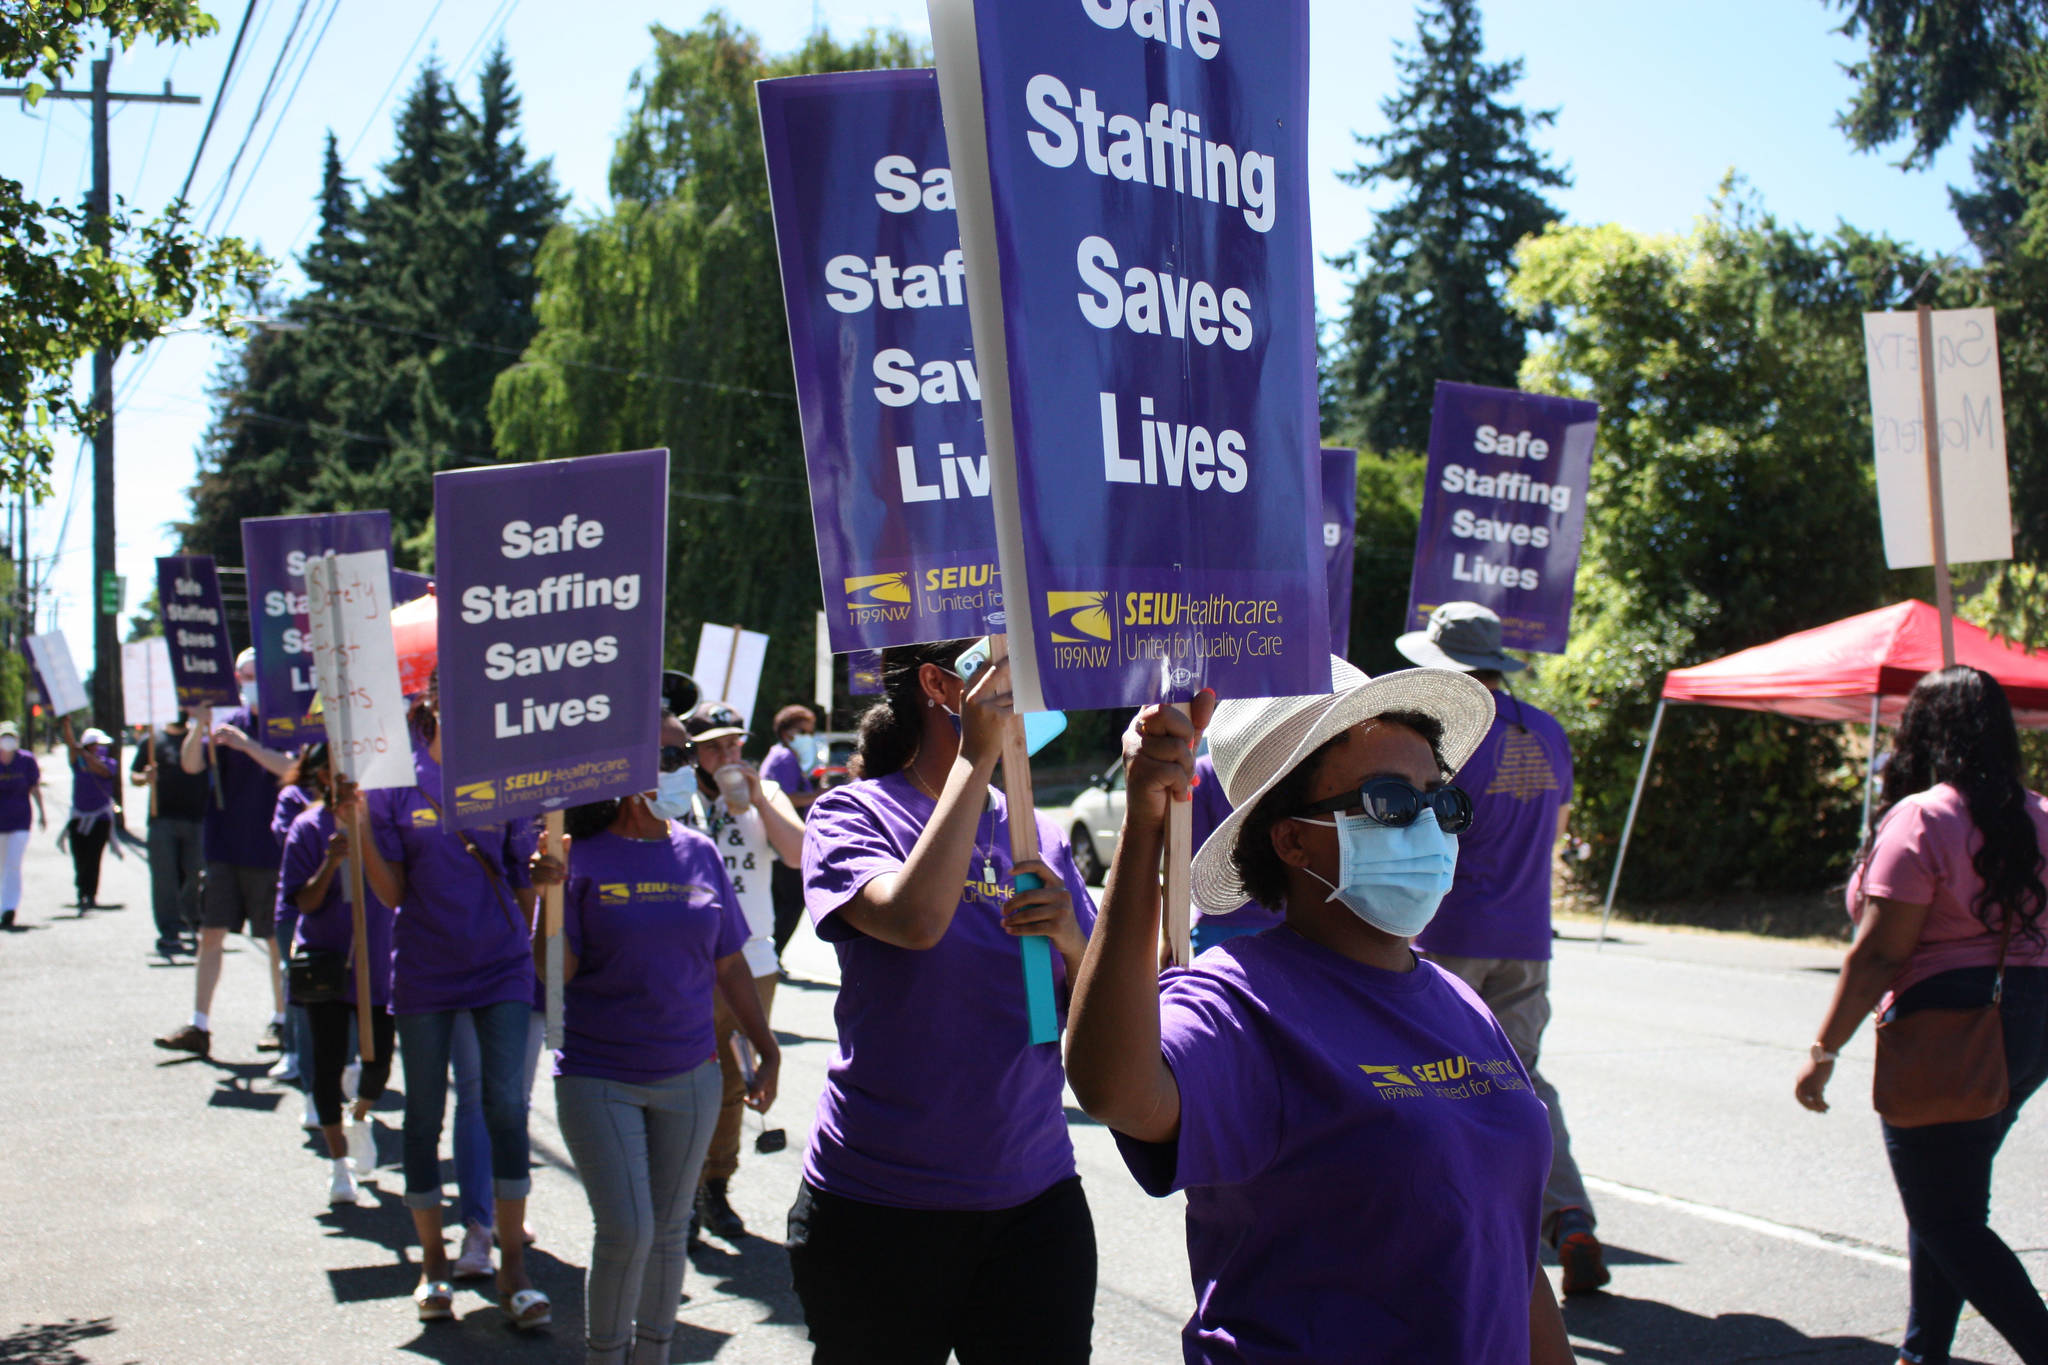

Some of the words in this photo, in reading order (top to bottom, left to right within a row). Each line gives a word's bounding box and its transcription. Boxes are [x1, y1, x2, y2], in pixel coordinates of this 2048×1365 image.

[1025, 73, 1276, 233] Staffing
[873, 154, 956, 213] Sa
[824, 248, 967, 314] Staf
[1076, 235, 1253, 351] Saves
[873, 348, 982, 407] Sav
[1100, 391, 1248, 493] Lives
[1473, 424, 1550, 461] Safe
[896, 443, 991, 503] Liv
[1440, 463, 1572, 513] Staffing
[500, 513, 604, 560] Safe
[1451, 508, 1550, 549] Saves
[1451, 552, 1540, 591] Lives
[460, 573, 641, 625] Staffing
[849, 605, 912, 626] 1199NW
[926, 591, 984, 614] United
[988, 588, 1004, 608] fo
[484, 634, 619, 681] Saves
[1054, 646, 1112, 670] 1199NW
[1125, 632, 1171, 661] United
[1174, 631, 1191, 659] for
[1194, 631, 1243, 665] Quality
[1246, 630, 1283, 656] Care
[494, 693, 611, 739] Lives
[505, 784, 544, 805] United
[1470, 1078, 1492, 1095] for
